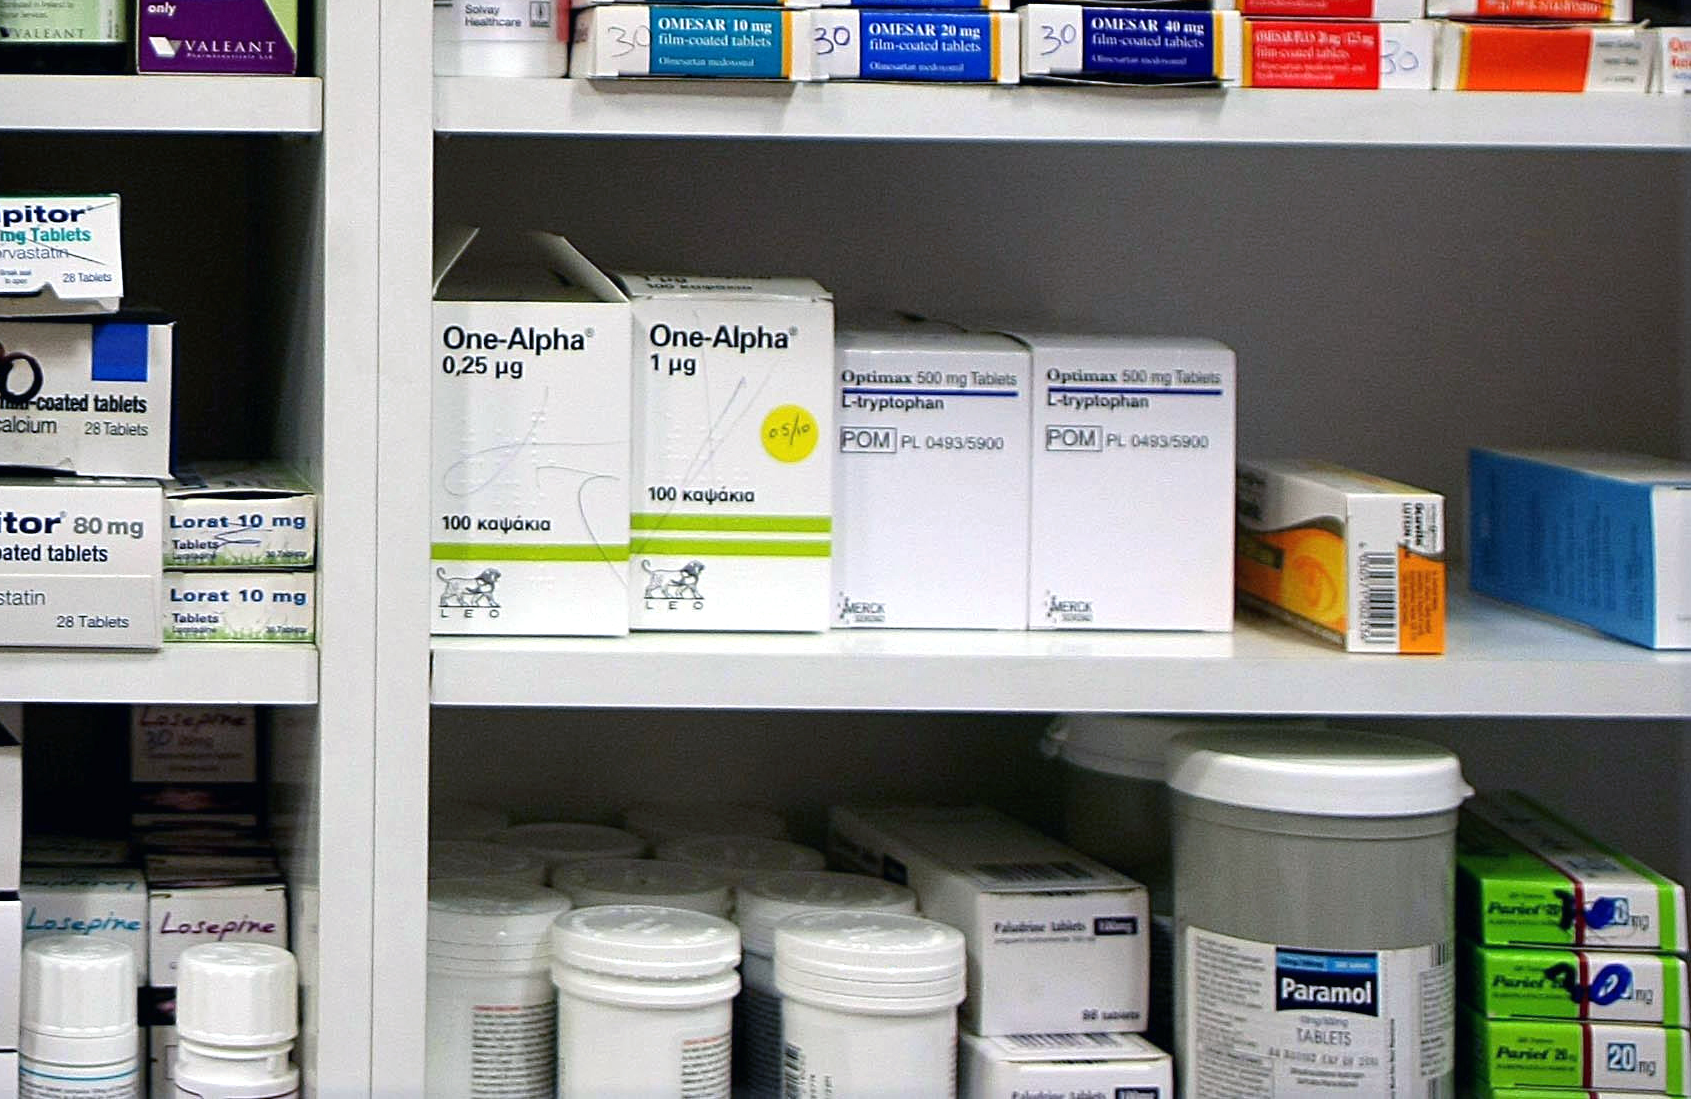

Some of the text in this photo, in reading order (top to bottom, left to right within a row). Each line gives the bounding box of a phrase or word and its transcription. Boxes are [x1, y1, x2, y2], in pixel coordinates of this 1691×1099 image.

[147, 2, 176, 15] only
[870, 23, 981, 39] OMESAR 20 mg
[1092, 18, 1204, 34] OMESAR 40 mg
[184, 40, 276, 53] VALEANT
[814, 27, 850, 54] 30
[443, 356, 487, 375] 0,25
[651, 354, 660, 371] 1
[842, 371, 1017, 388] Optimax 500 mg Tablets
[842, 396, 944, 411] L-tryptophan
[842, 431, 1003, 450] POM PL 0493/5900
[74, 519, 102, 534] 80
[108, 519, 144, 538] mg
[442, 515, 551, 532] 100 καψάκια
[48, 545, 108, 562] tablets
[170, 589, 306, 606] Lorat 10 mg
[57, 616, 129, 628] 28 Tablets
[160, 911, 277, 939] Losepine
[1281, 977, 1372, 1004] Paramol
[1297, 1028, 1352, 1046] TABLETS
[1609, 1045, 1656, 1076] 20 mg
